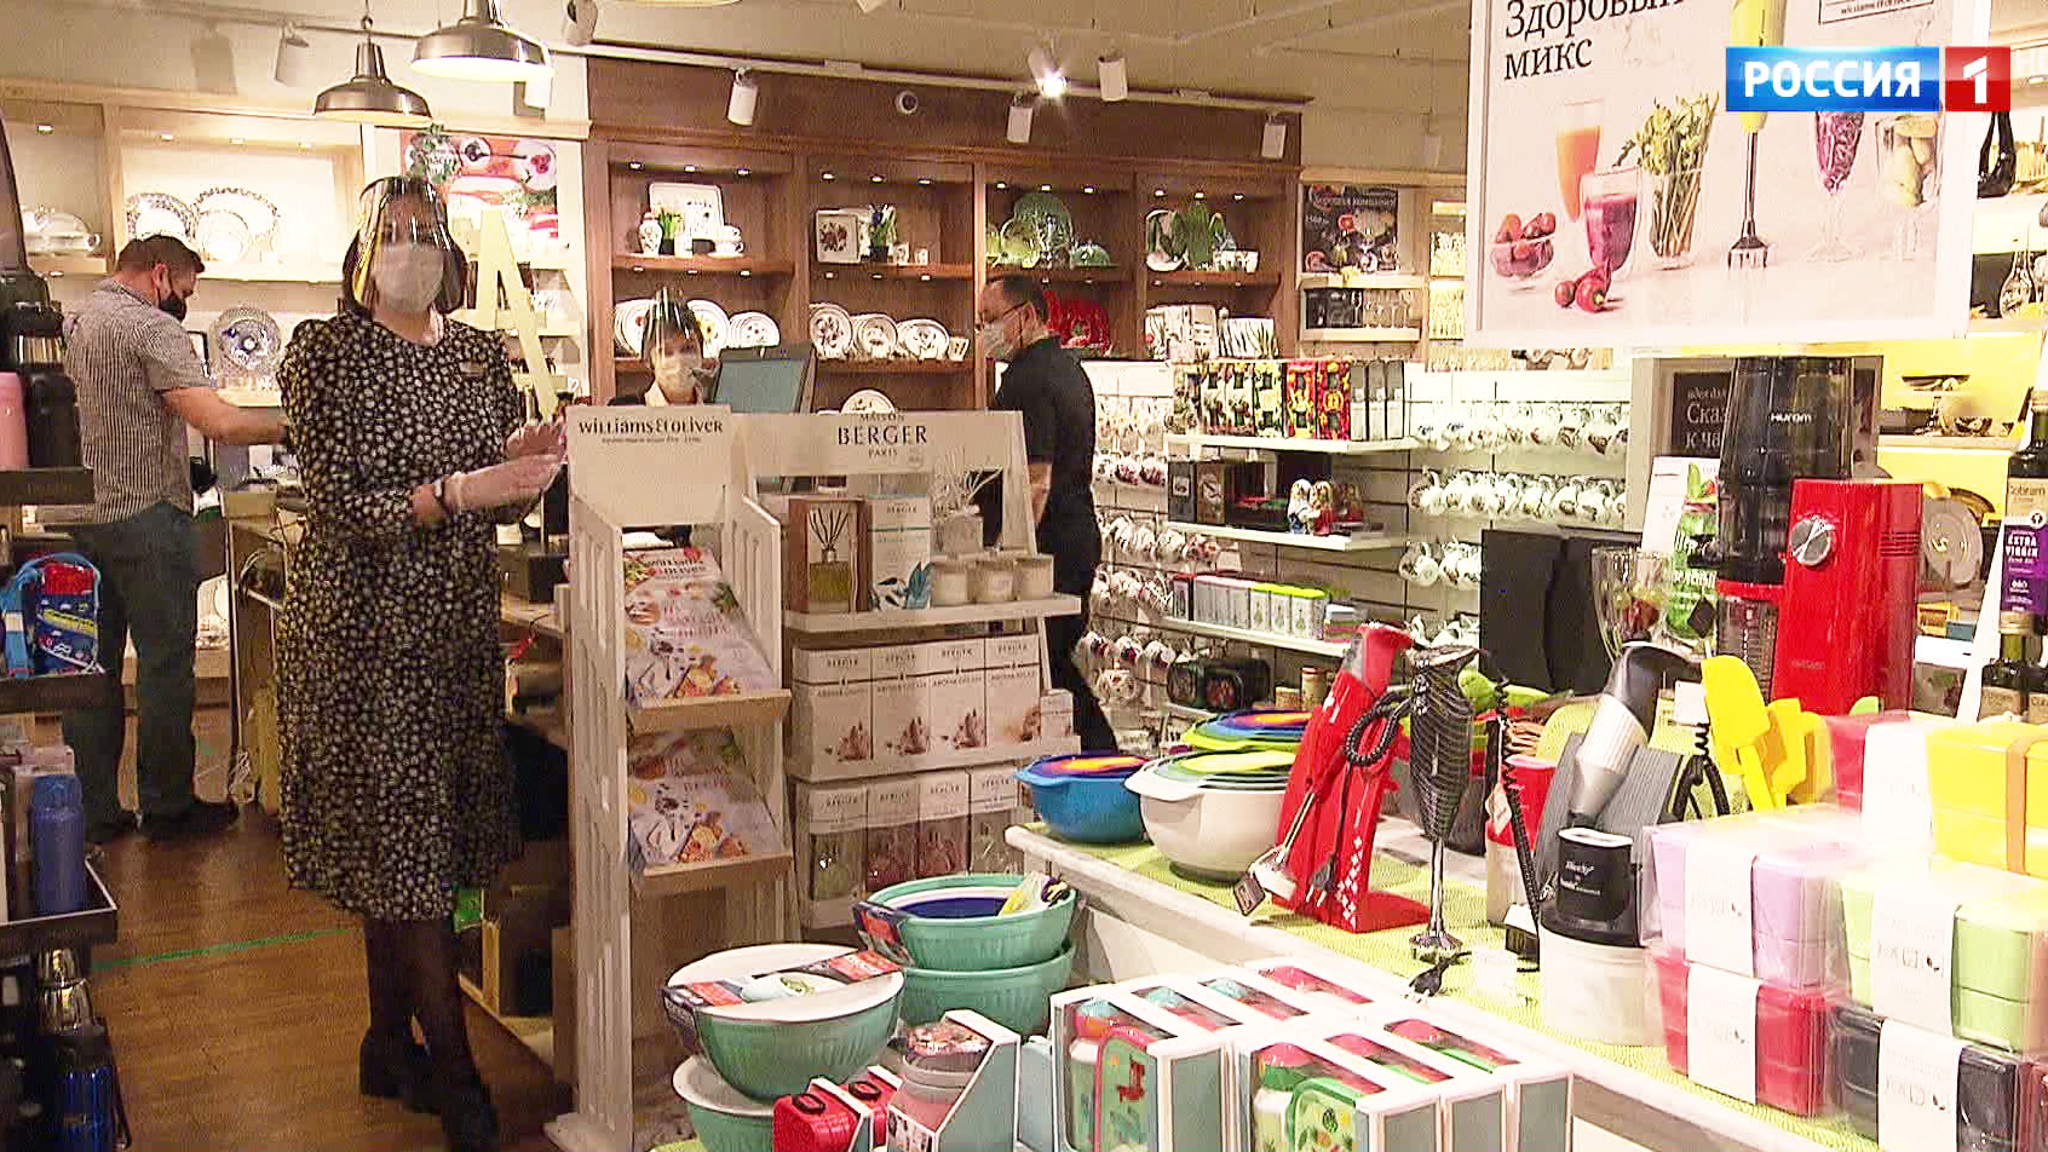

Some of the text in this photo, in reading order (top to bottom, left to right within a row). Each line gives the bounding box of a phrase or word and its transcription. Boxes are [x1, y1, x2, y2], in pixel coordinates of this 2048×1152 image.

[1505, 0, 1684, 42] Здоров
[1504, 38, 1593, 81] микс
[837, 424, 928, 446] BERGER
[1701, 431, 1721, 450] ча
[868, 448, 899, 458] PARIS
